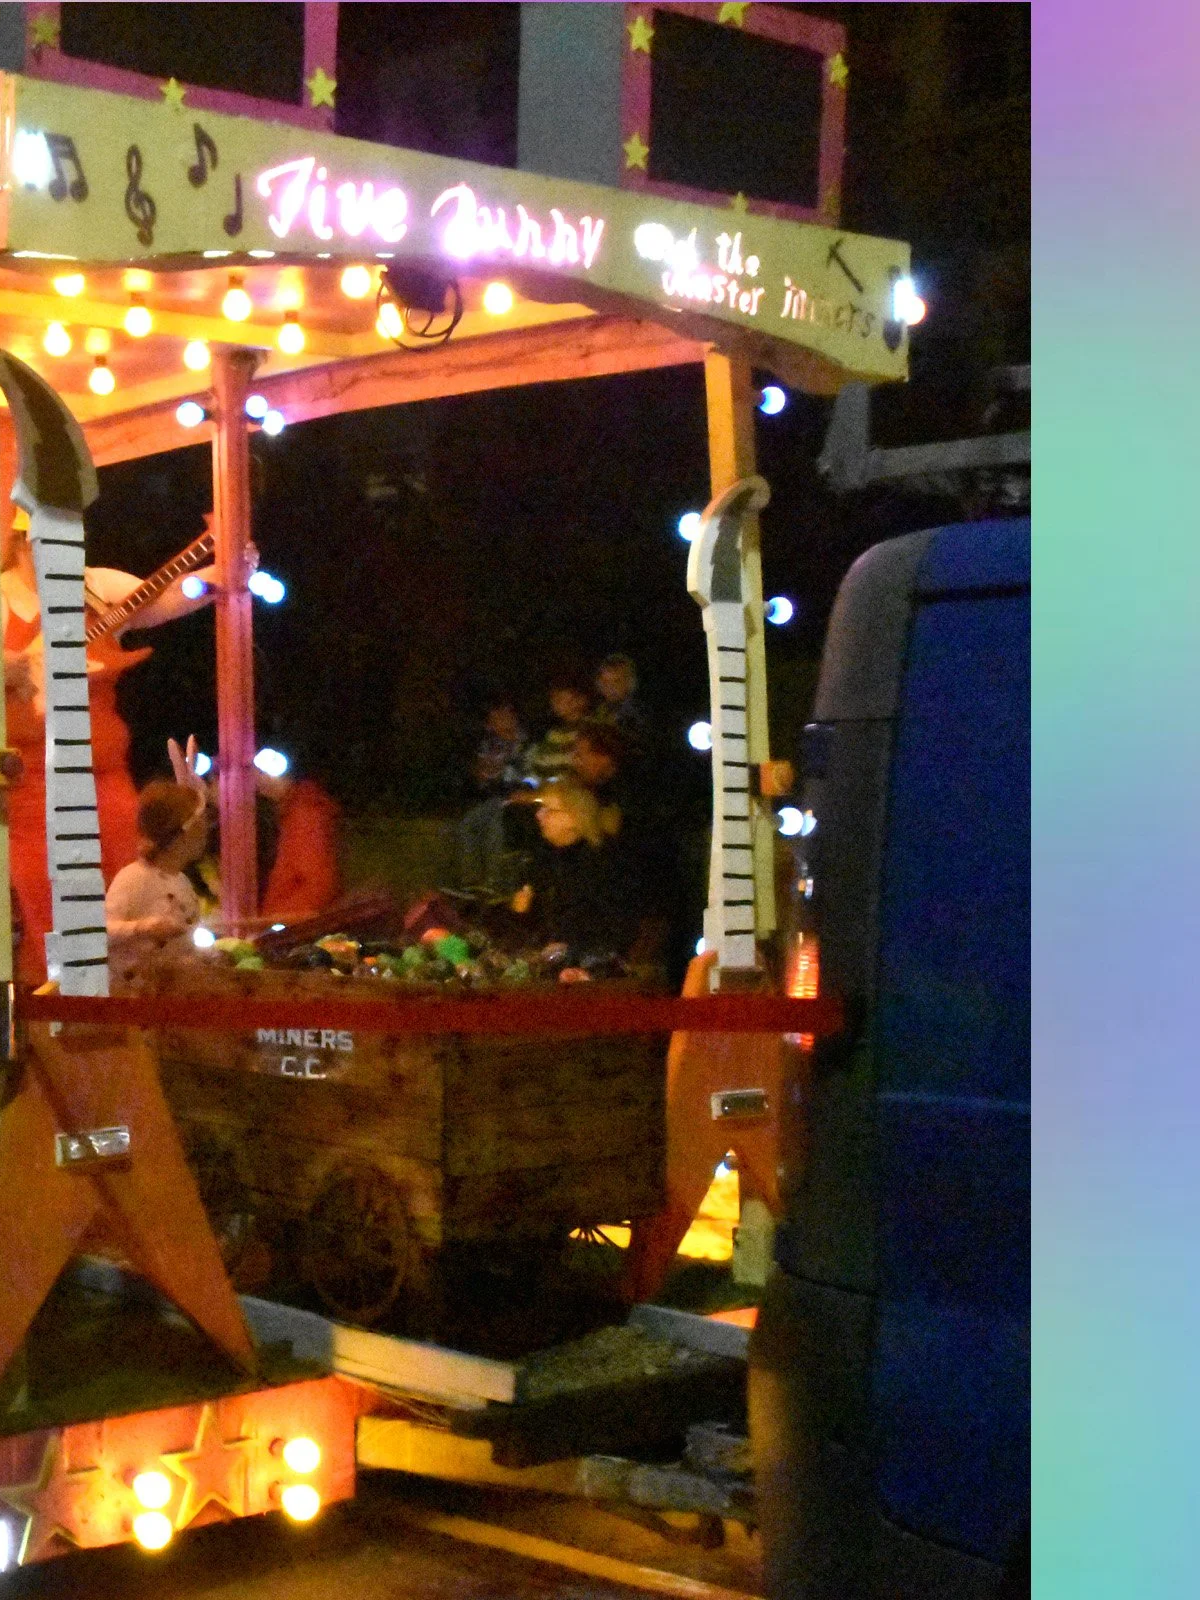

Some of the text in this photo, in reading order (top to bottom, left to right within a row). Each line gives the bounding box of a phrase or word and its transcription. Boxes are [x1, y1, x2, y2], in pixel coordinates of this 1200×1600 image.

[257, 156, 407, 242] Jive
[715, 232, 760, 277] the
[256, 1028, 354, 1051] MINERS
